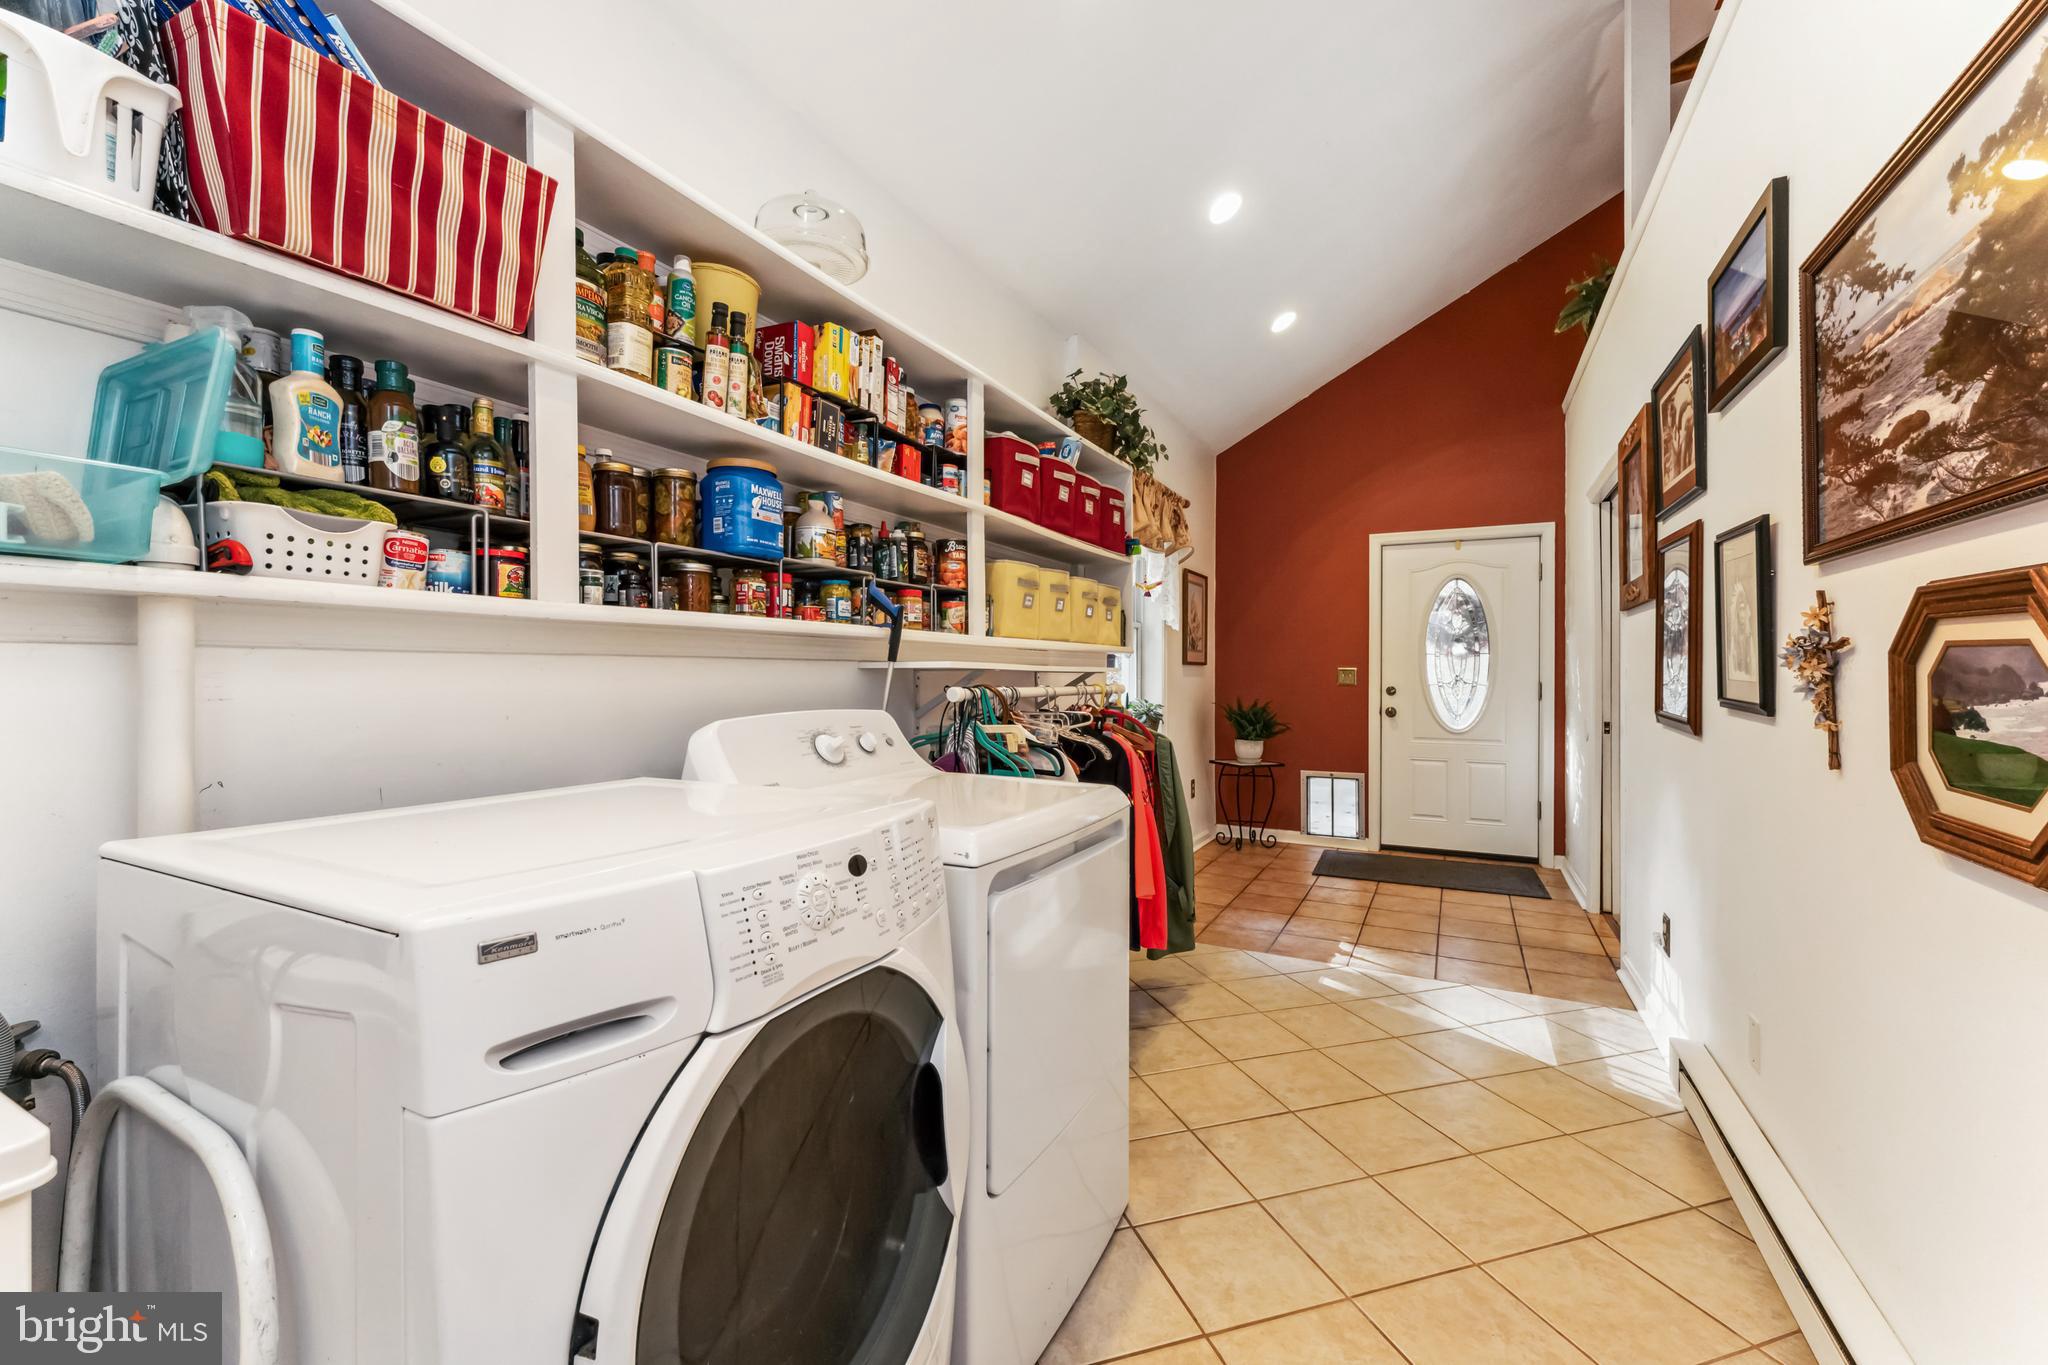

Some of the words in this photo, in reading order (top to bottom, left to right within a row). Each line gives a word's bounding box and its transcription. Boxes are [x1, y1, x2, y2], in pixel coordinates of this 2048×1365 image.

[326, 32, 371, 82] Reyno
[764, 341, 775, 376] Down
[774, 335, 785, 377] Swans
[308, 406, 332, 421] RANCH
[751, 483, 783, 501] MAXWELL
[762, 497, 783, 510] HOUSE
